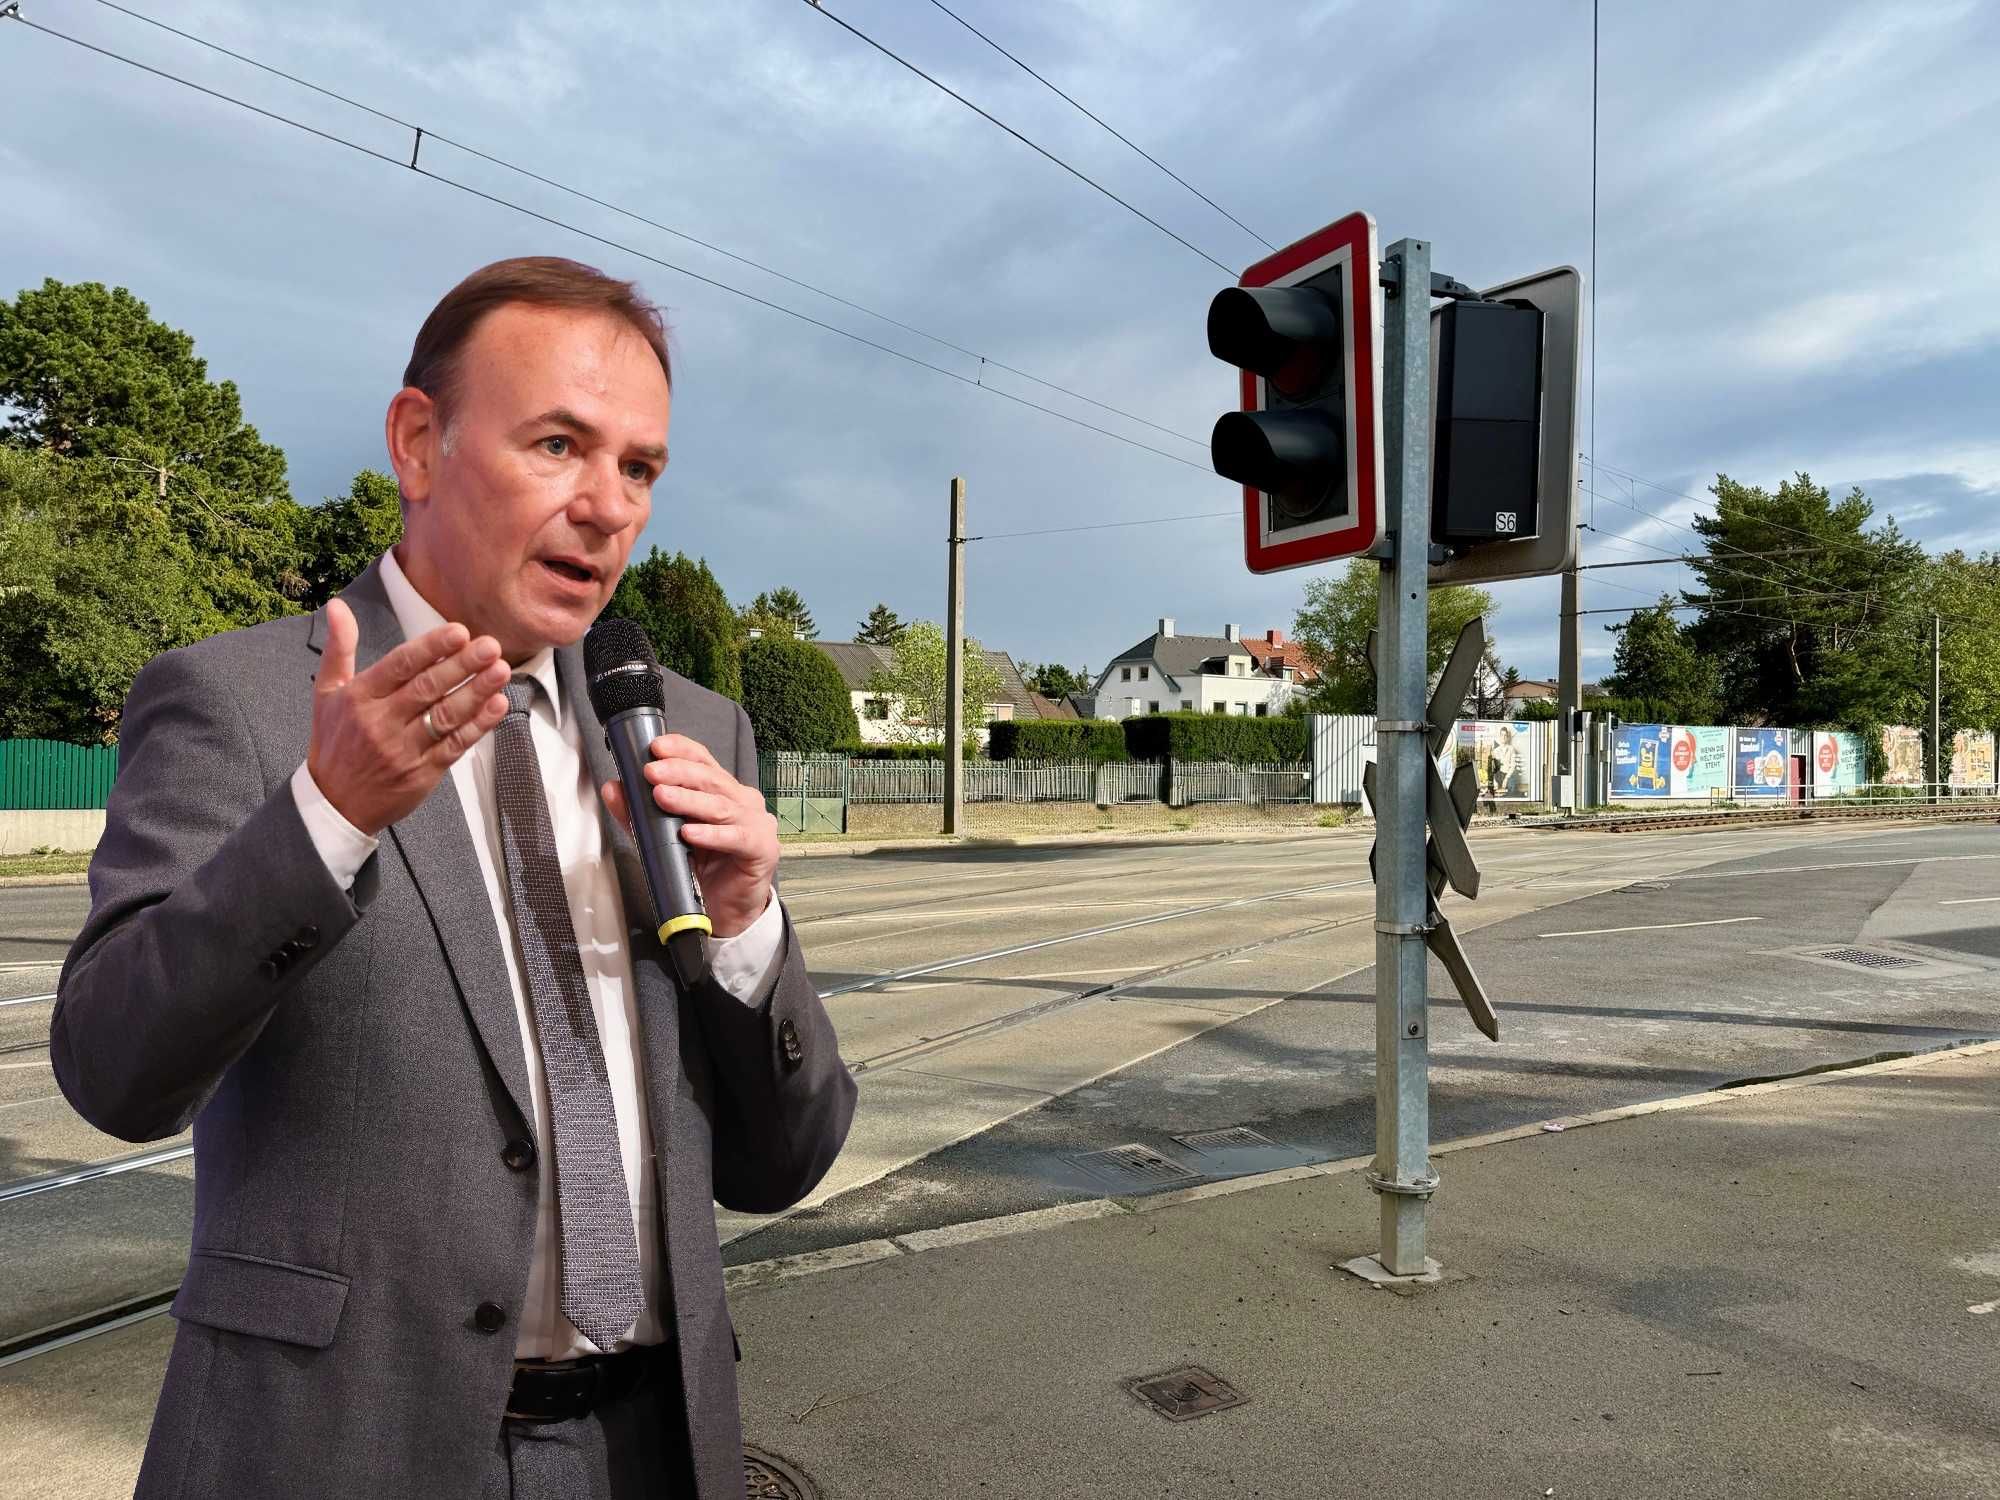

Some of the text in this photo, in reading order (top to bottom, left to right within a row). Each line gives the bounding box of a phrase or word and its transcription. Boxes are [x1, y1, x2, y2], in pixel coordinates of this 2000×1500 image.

[1497, 513, 1515, 531] S6
[1700, 746, 1715, 754] WENN
[1705, 761, 1720, 769] STEHT
